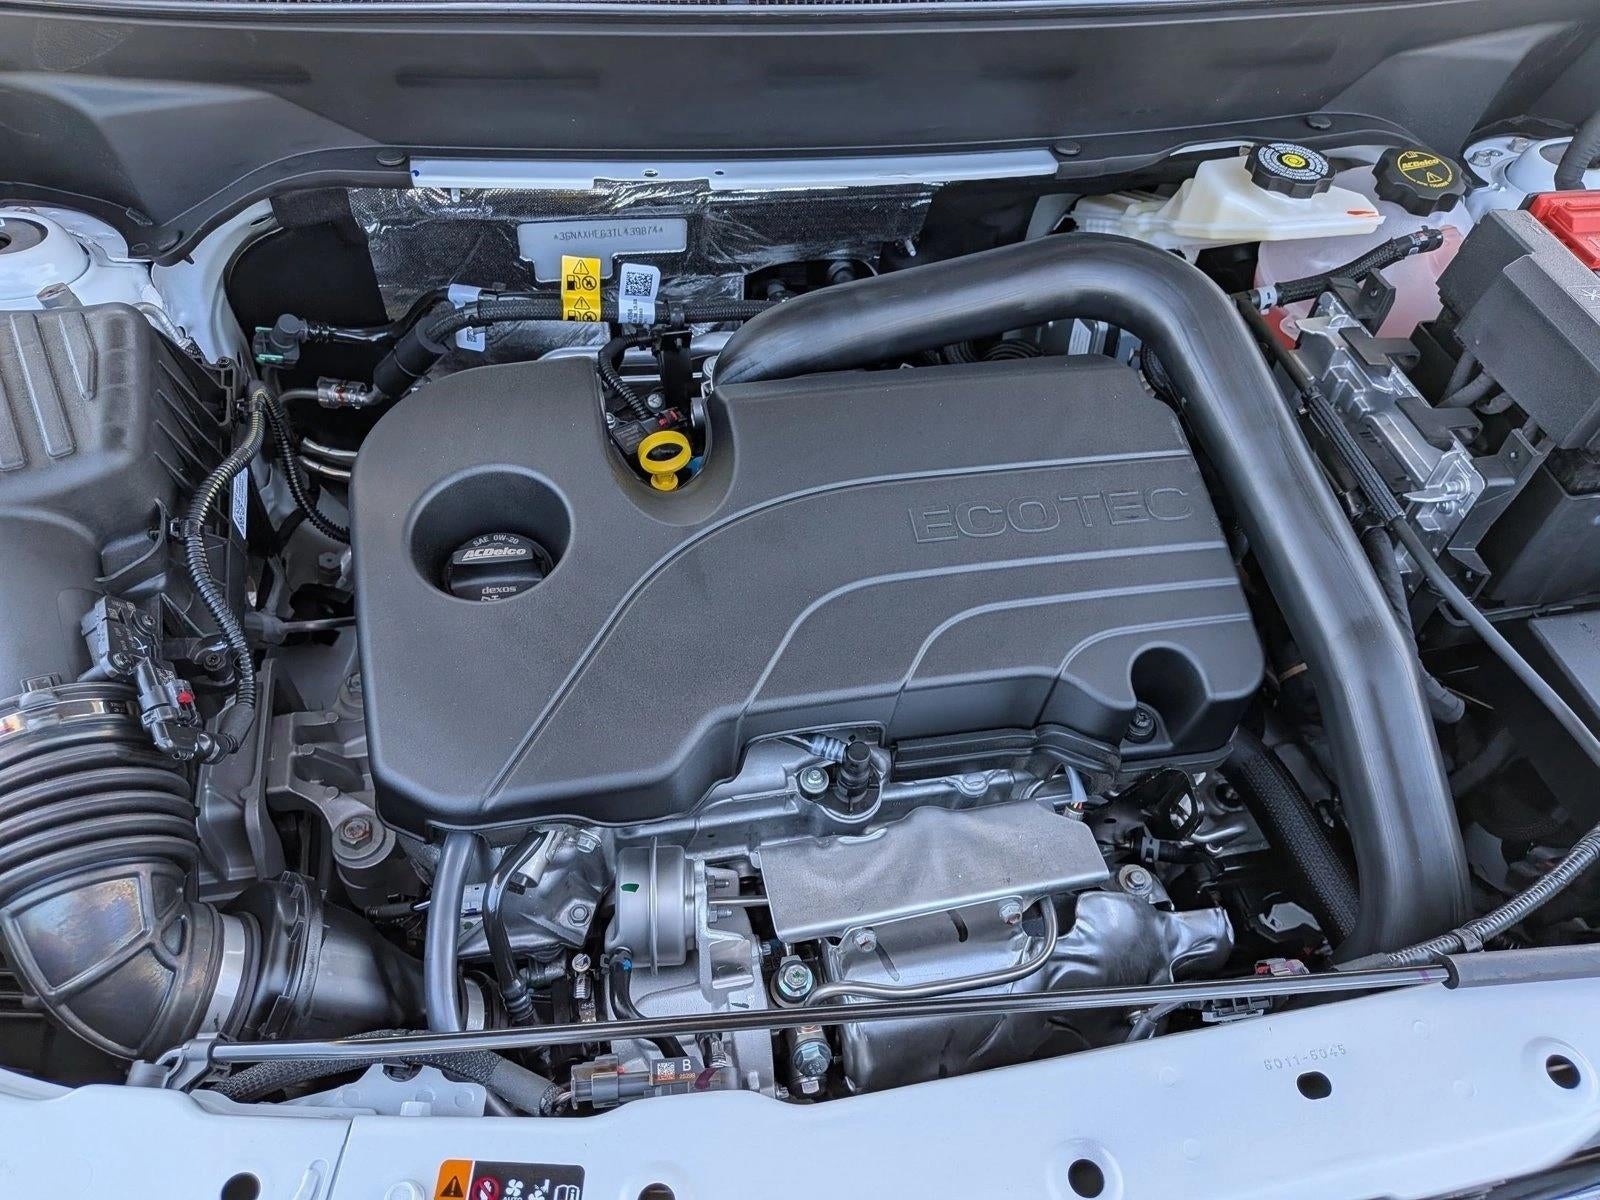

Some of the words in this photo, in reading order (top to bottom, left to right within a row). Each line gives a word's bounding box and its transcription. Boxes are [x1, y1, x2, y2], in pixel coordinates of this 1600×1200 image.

[908, 487, 1193, 543] ECOTEC
[473, 536, 489, 546] SAE
[493, 534, 519, 545] 0W-20
[461, 547, 527, 561] ACDelco
[481, 586, 516, 594] dexos
[682, 1059, 692, 1072] B
